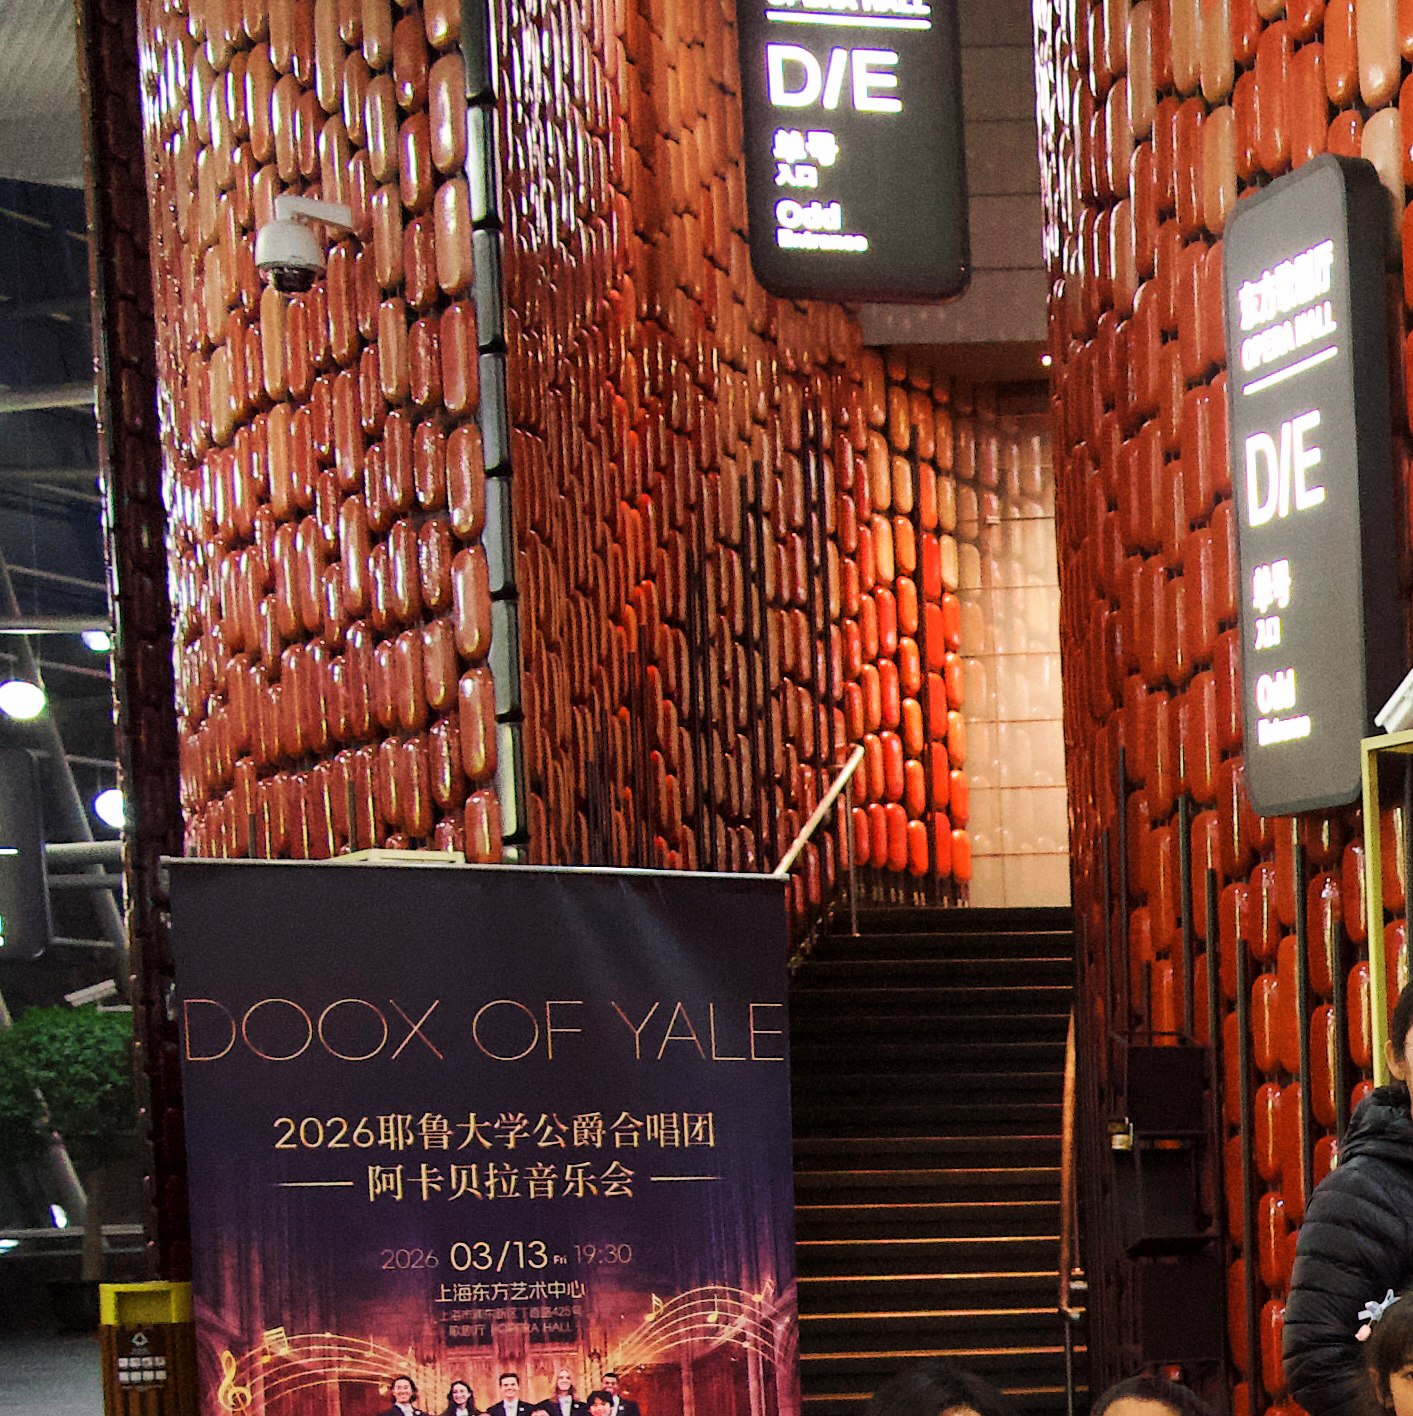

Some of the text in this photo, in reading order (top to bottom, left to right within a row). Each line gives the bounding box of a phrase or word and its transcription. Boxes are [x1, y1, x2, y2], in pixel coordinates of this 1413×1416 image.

[766, 43, 903, 113] D/E
[774, 197, 842, 231] Odd
[1245, 408, 1327, 528] D/E
[184, 998, 785, 1061] DOOX OF YALE
[272, 1110, 717, 1152] 2026耶鲁大学公爵合唱团
[367, 1161, 637, 1202] 阿卡贝拉音乐会
[381, 1240, 633, 1272] 2026 03/13 Fri 19:30
[435, 1280, 587, 1303] 上海东方艺术中心
[543, 1321, 574, 1333] HALL
